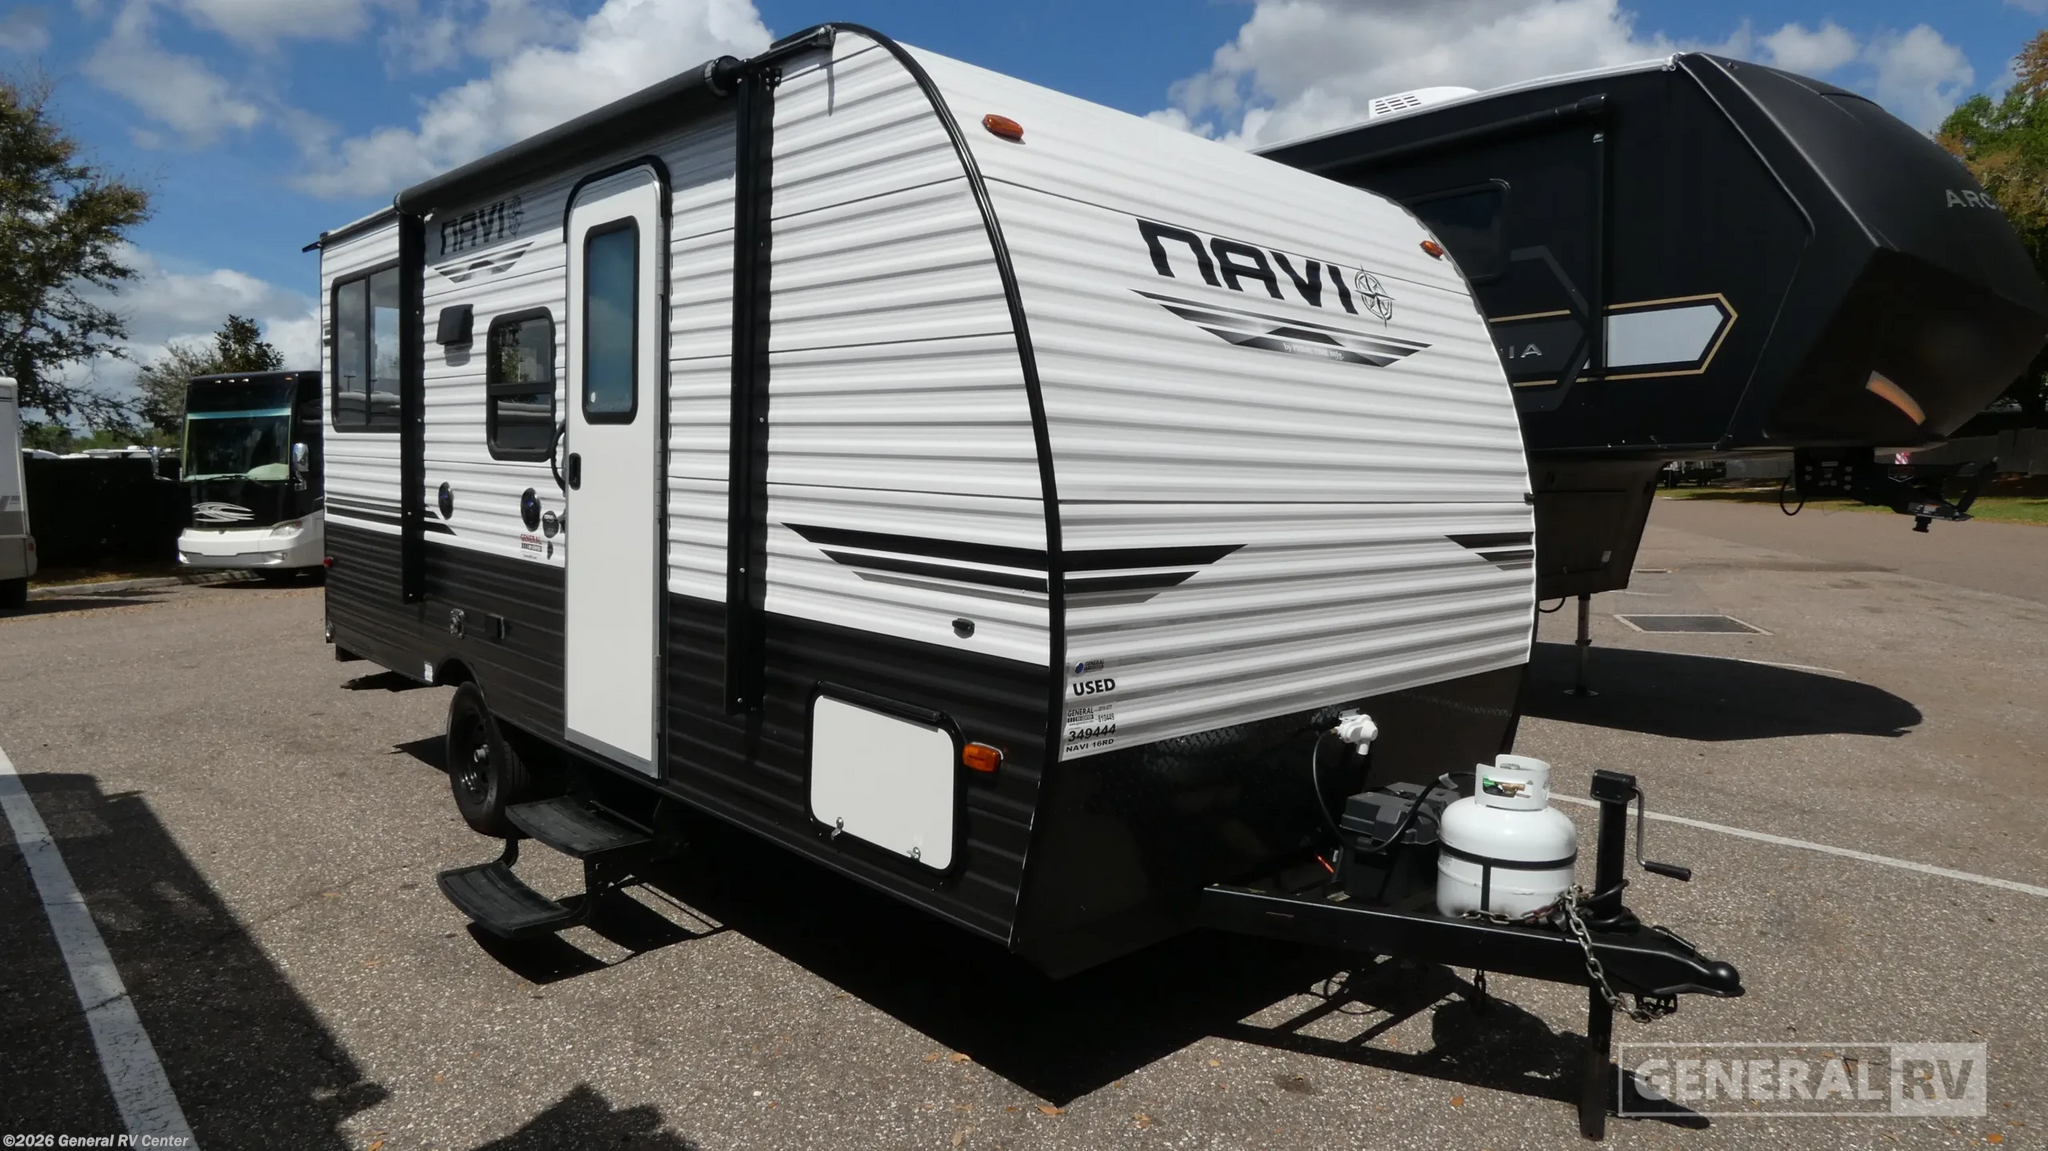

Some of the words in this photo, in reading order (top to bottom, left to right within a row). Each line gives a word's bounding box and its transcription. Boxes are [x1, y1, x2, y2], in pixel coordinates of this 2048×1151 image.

[1136, 218, 1359, 315] NAVI
[1072, 678, 1116, 697] USED
[1067, 707, 1094, 718] GENERAL
[1068, 723, 1116, 742] 349444
[1066, 743, 1089, 753] NAVI
[1092, 738, 1114, 748] 16RD
